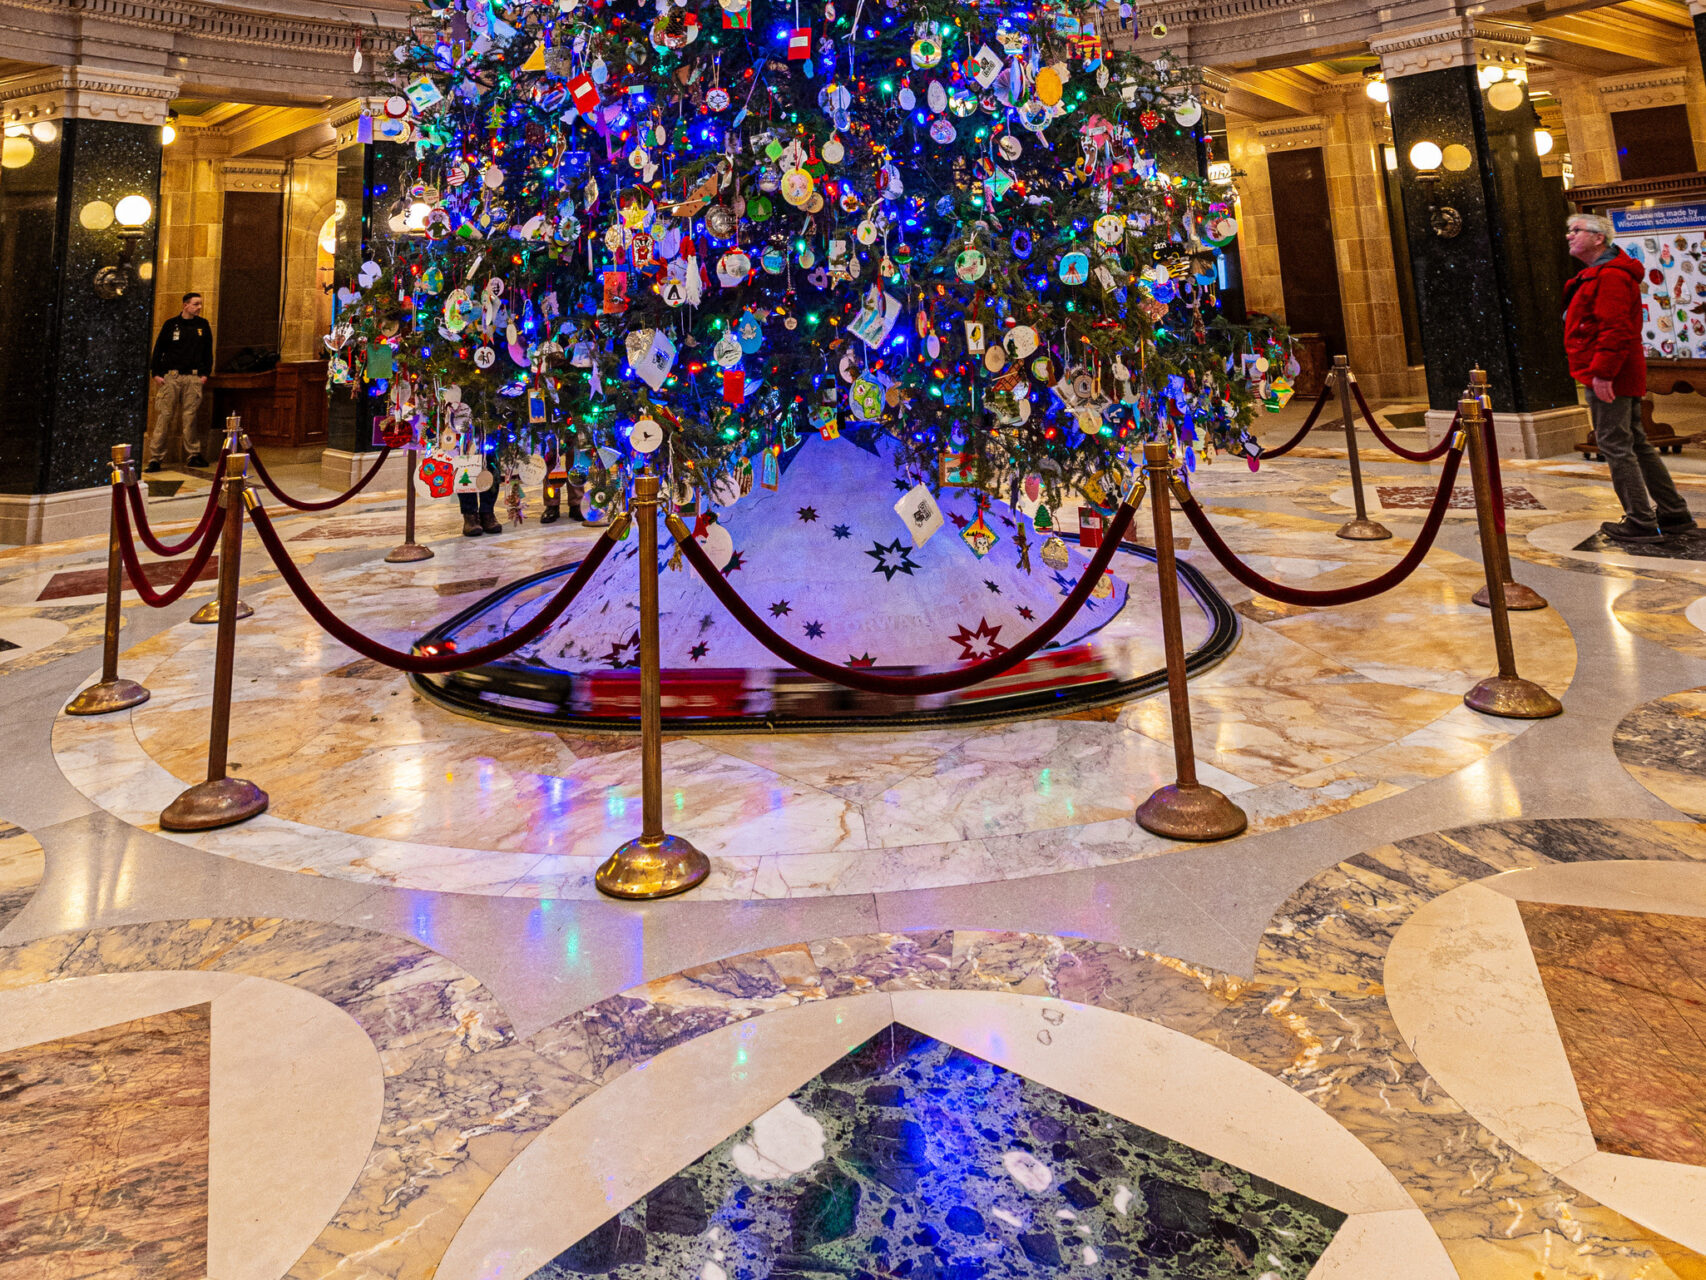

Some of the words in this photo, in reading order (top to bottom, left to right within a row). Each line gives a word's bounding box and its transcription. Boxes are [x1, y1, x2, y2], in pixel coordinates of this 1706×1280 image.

[1626, 211, 1664, 220] Ornaments
[1666, 209, 1686, 217] made
[1688, 208, 1698, 217] by
[1617, 218, 1653, 228] Wisconsin
